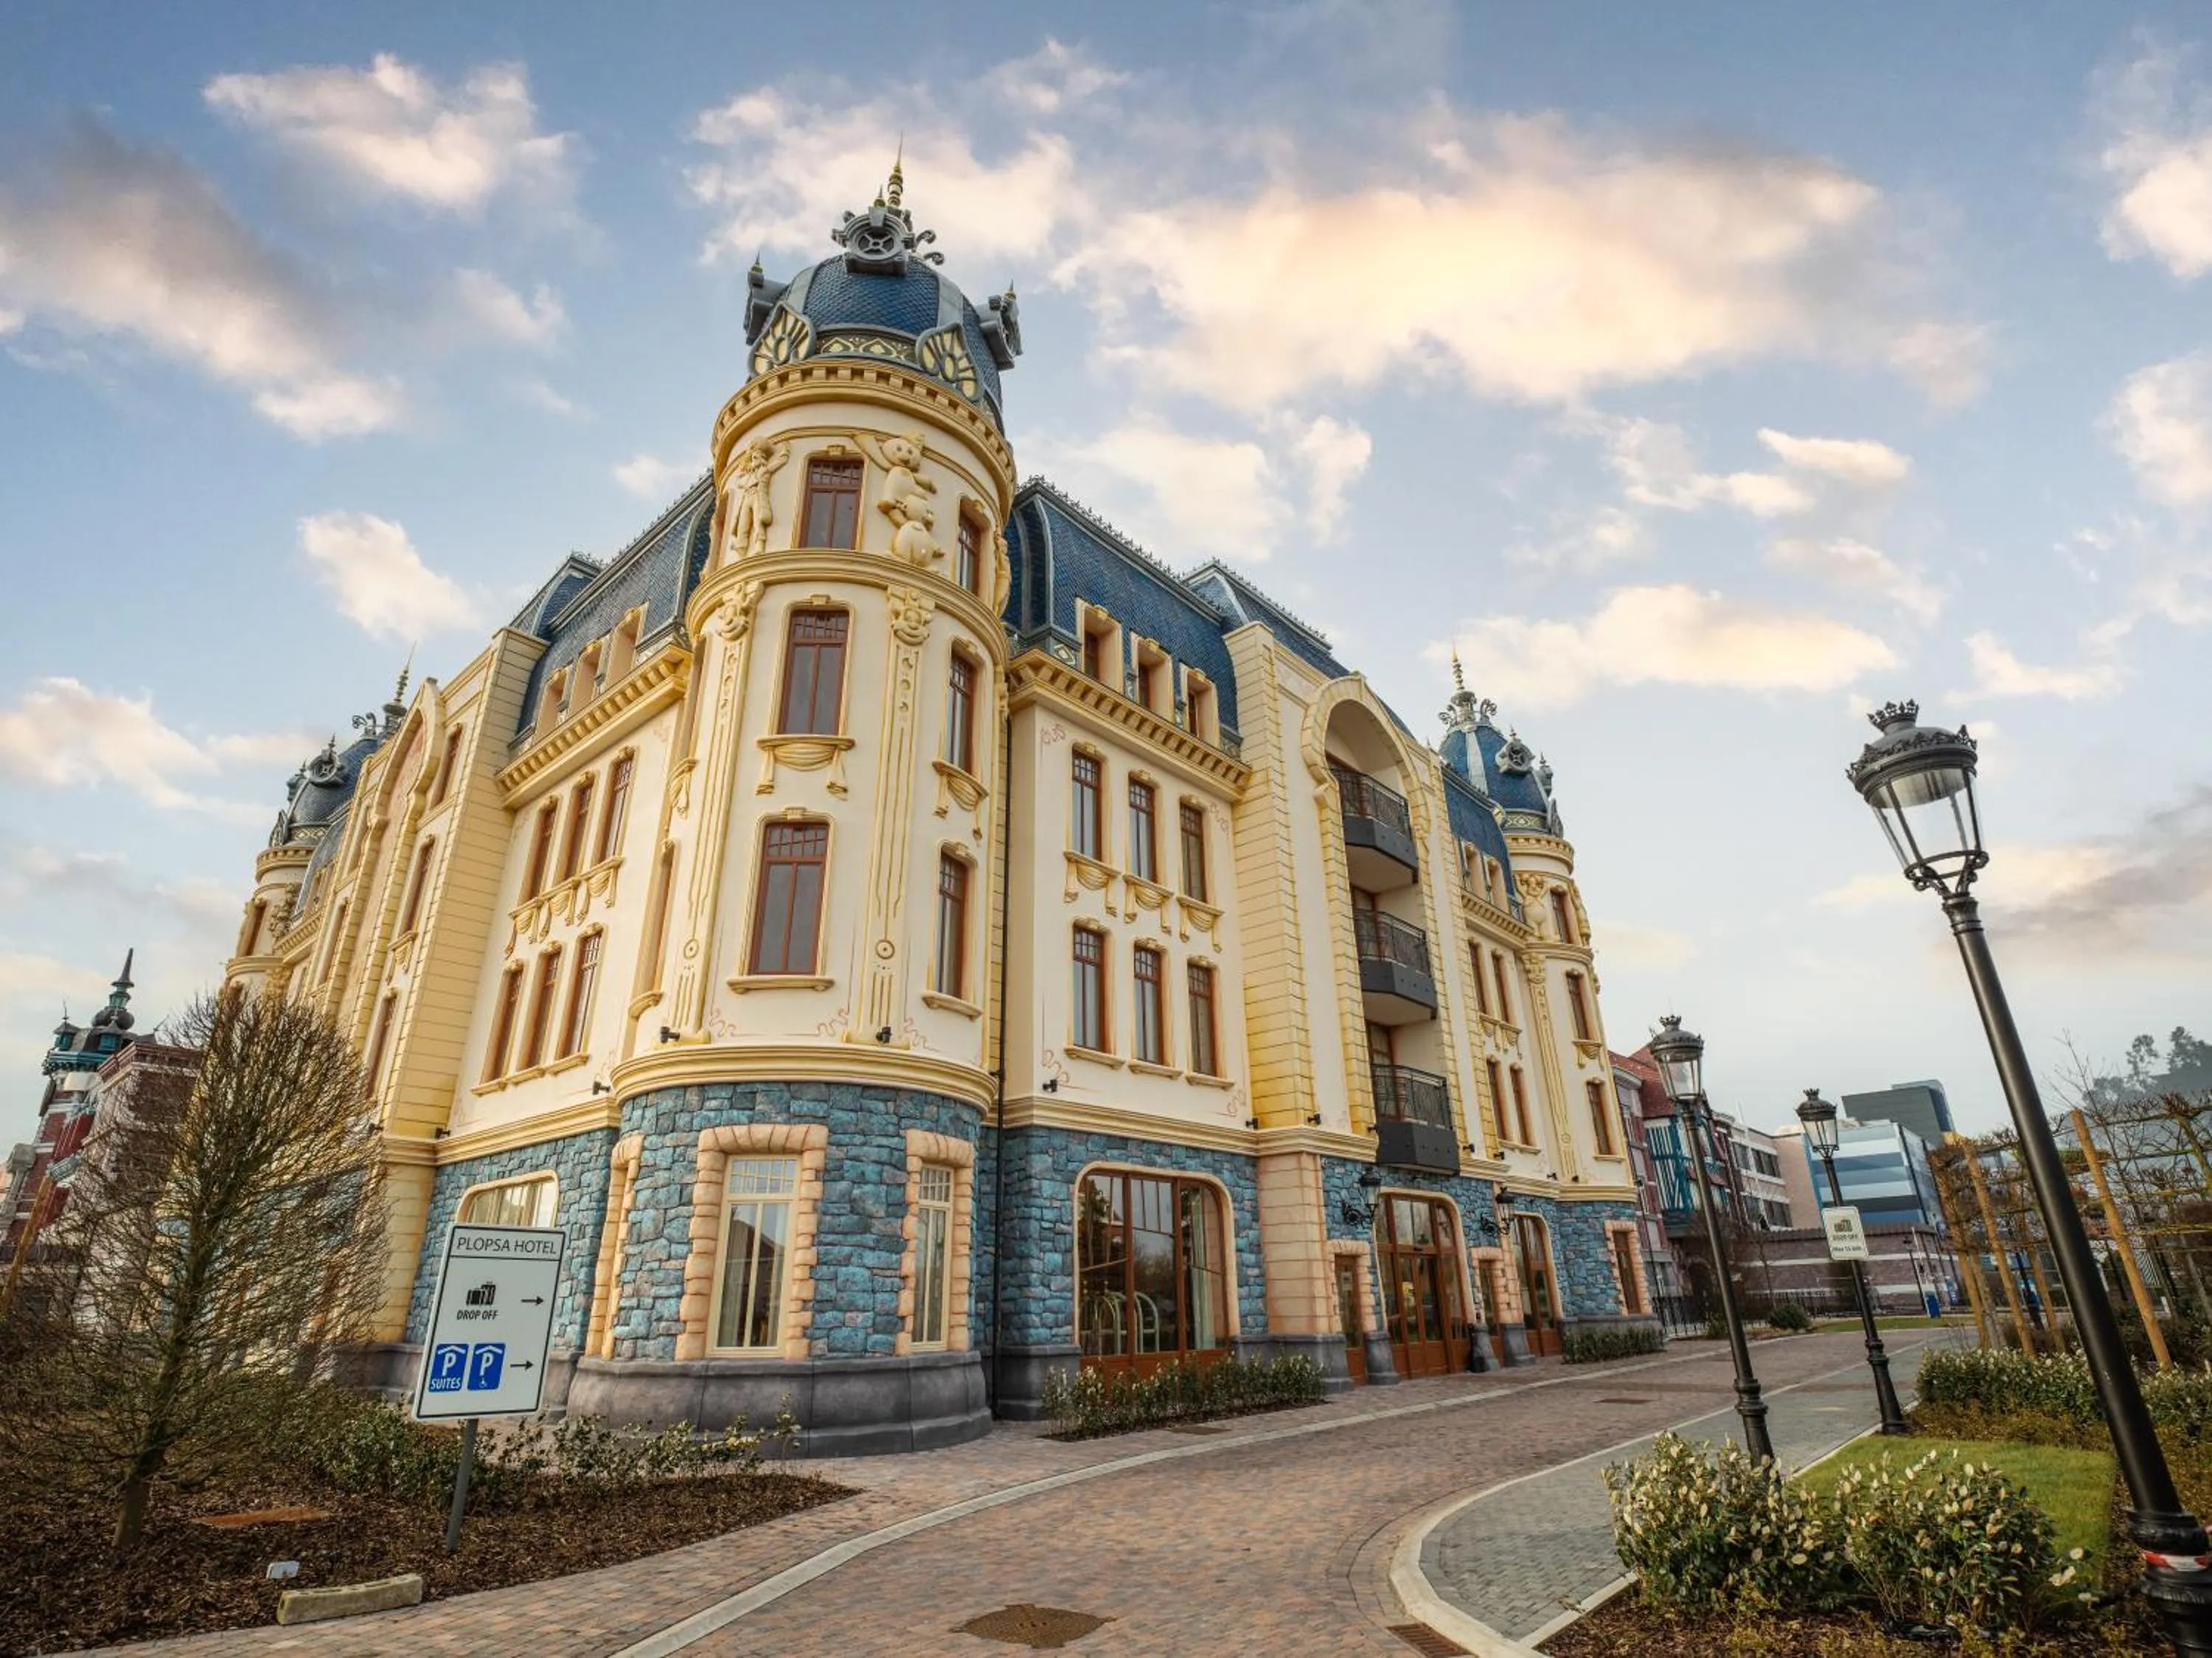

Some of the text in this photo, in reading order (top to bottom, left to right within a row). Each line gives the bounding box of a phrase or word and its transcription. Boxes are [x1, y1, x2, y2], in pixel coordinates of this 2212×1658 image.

[456, 1237, 557, 1254] PLOPSA HOTEL
[456, 1310, 498, 1320] DROP OFF
[442, 1353, 456, 1376] P
[480, 1353, 494, 1376] P
[430, 1377, 462, 1390] SUITES
